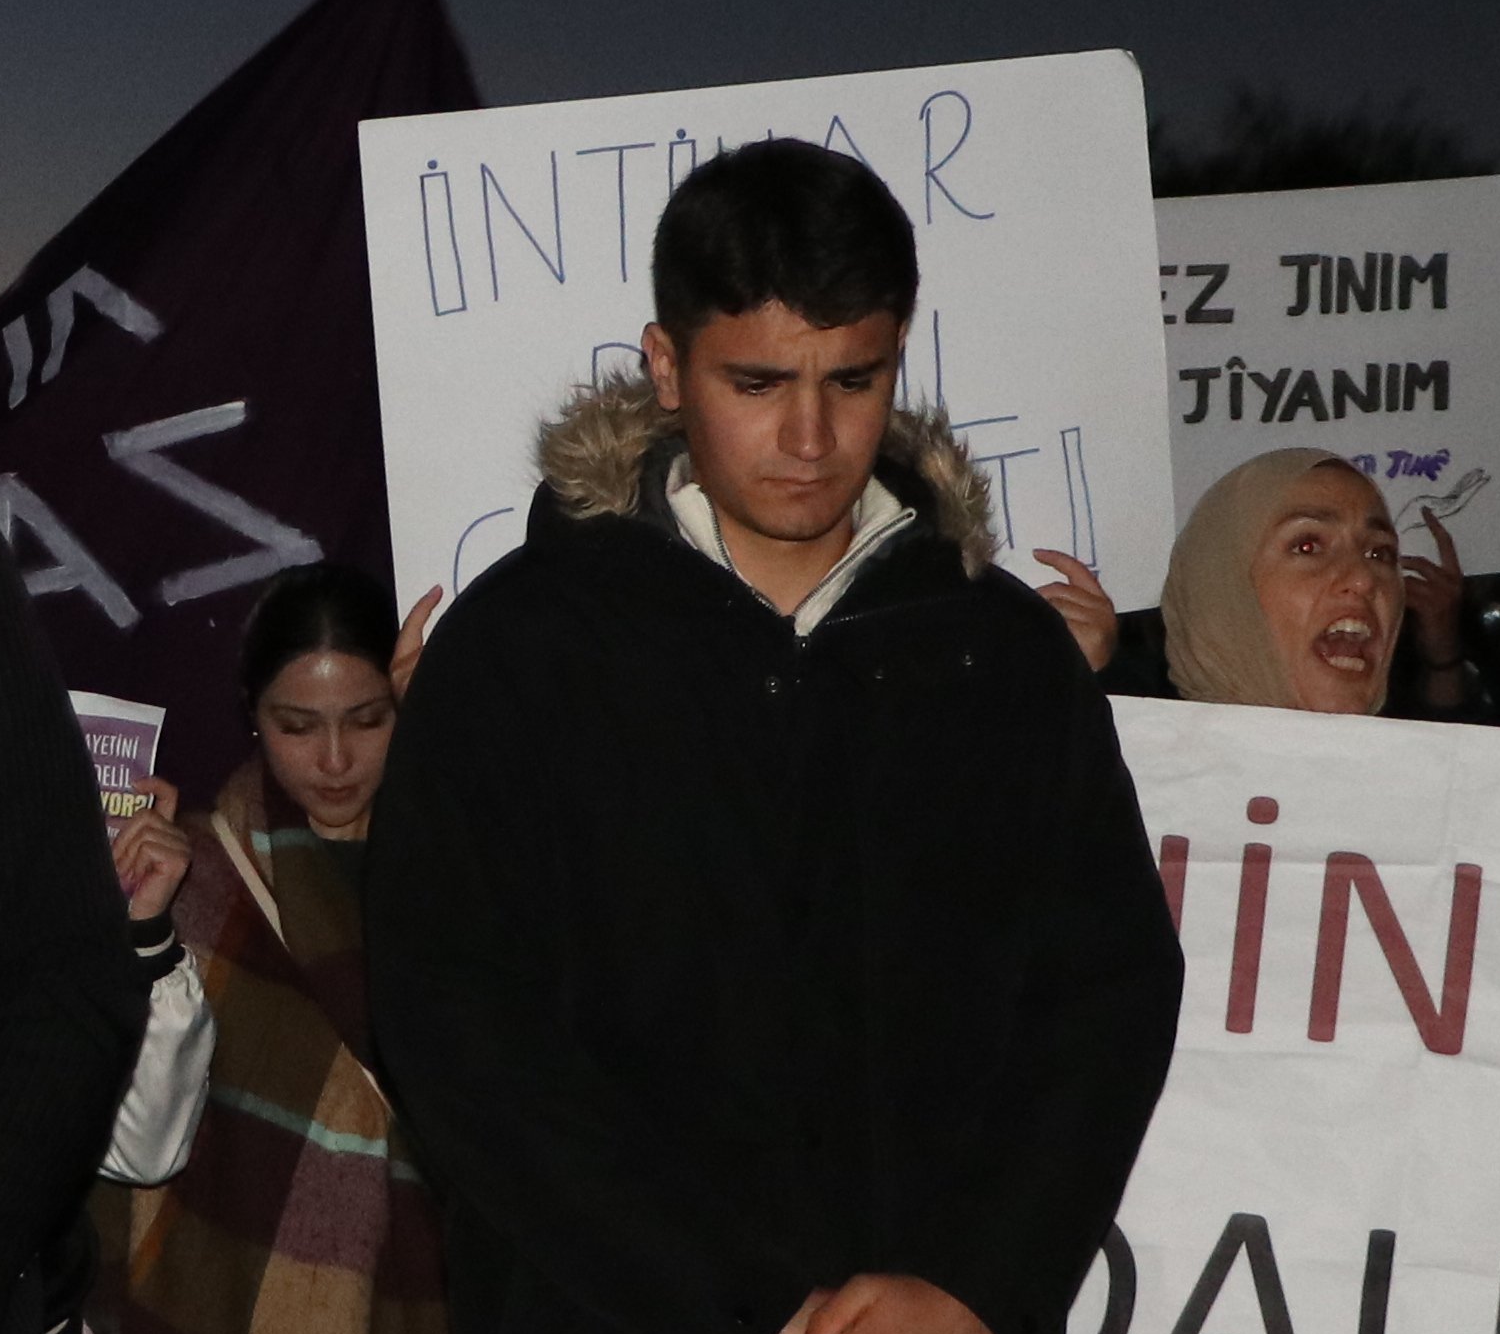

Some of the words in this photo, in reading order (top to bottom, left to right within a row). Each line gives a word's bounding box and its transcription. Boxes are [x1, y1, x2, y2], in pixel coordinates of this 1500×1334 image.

[419, 89, 997, 317] İNTR
[1279, 251, 1449, 317] JINIM
[1178, 355, 1449, 424] JÎYANIM
